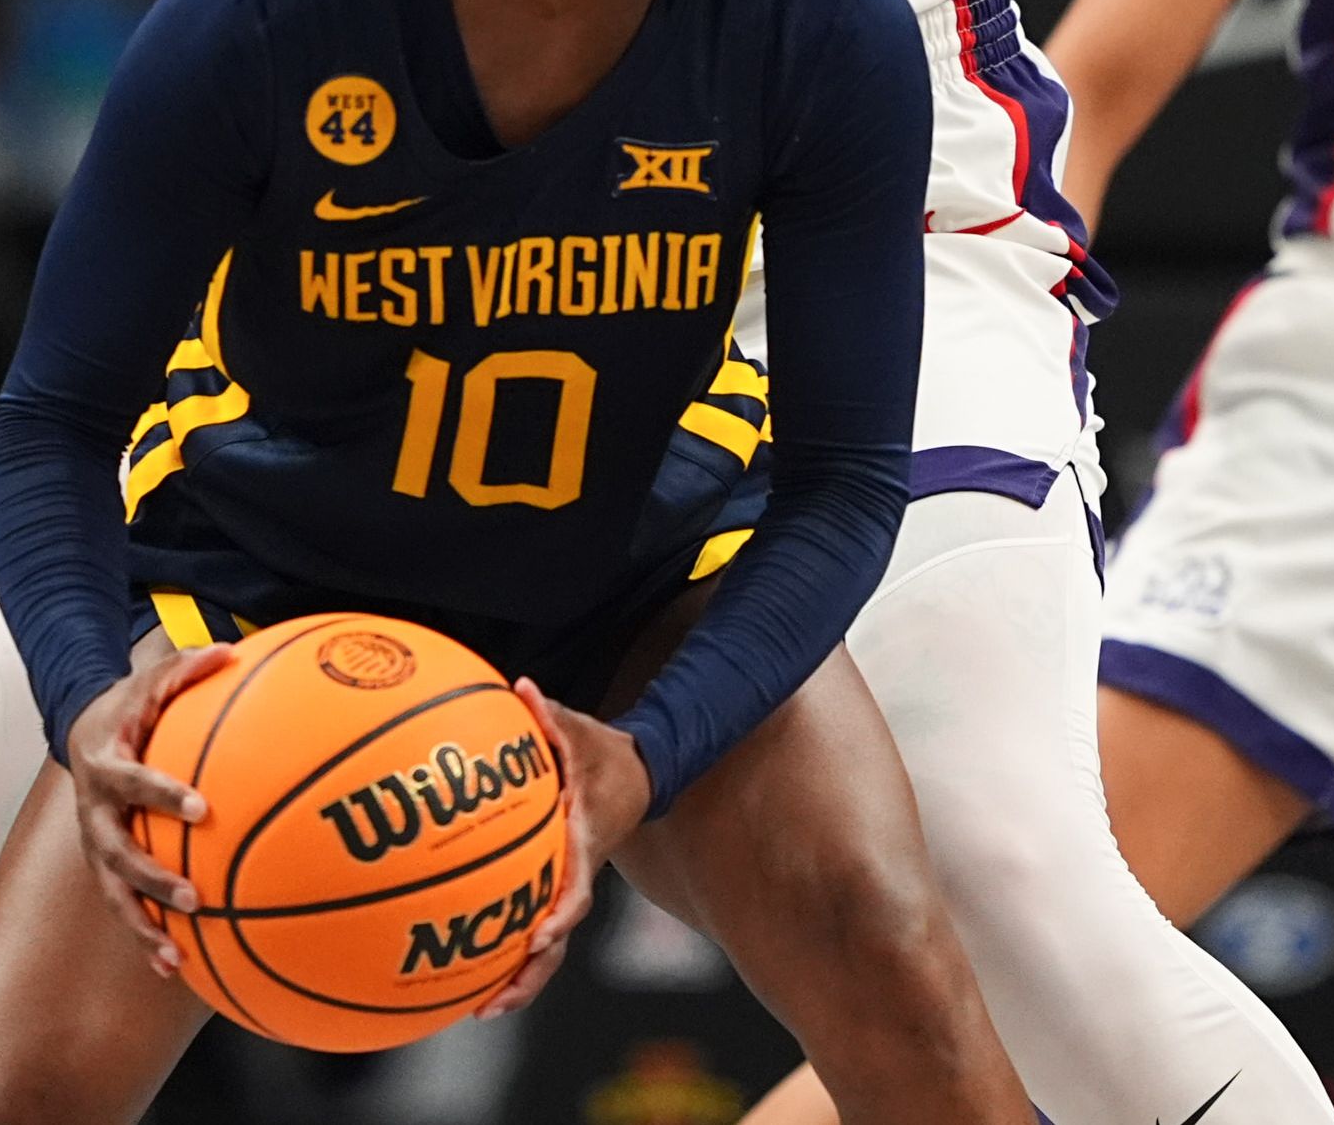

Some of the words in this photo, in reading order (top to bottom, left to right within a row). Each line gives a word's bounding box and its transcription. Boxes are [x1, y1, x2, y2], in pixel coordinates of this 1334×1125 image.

[320, 110, 376, 145] 44
[327, 94, 376, 109] WEST
[619, 143, 713, 194] XII
[300, 246, 453, 327] WEST
[465, 231, 722, 327] VIRGINIA
[392, 350, 598, 510] 10
[320, 731, 550, 863] Wilson
[400, 855, 554, 974] NCAA
